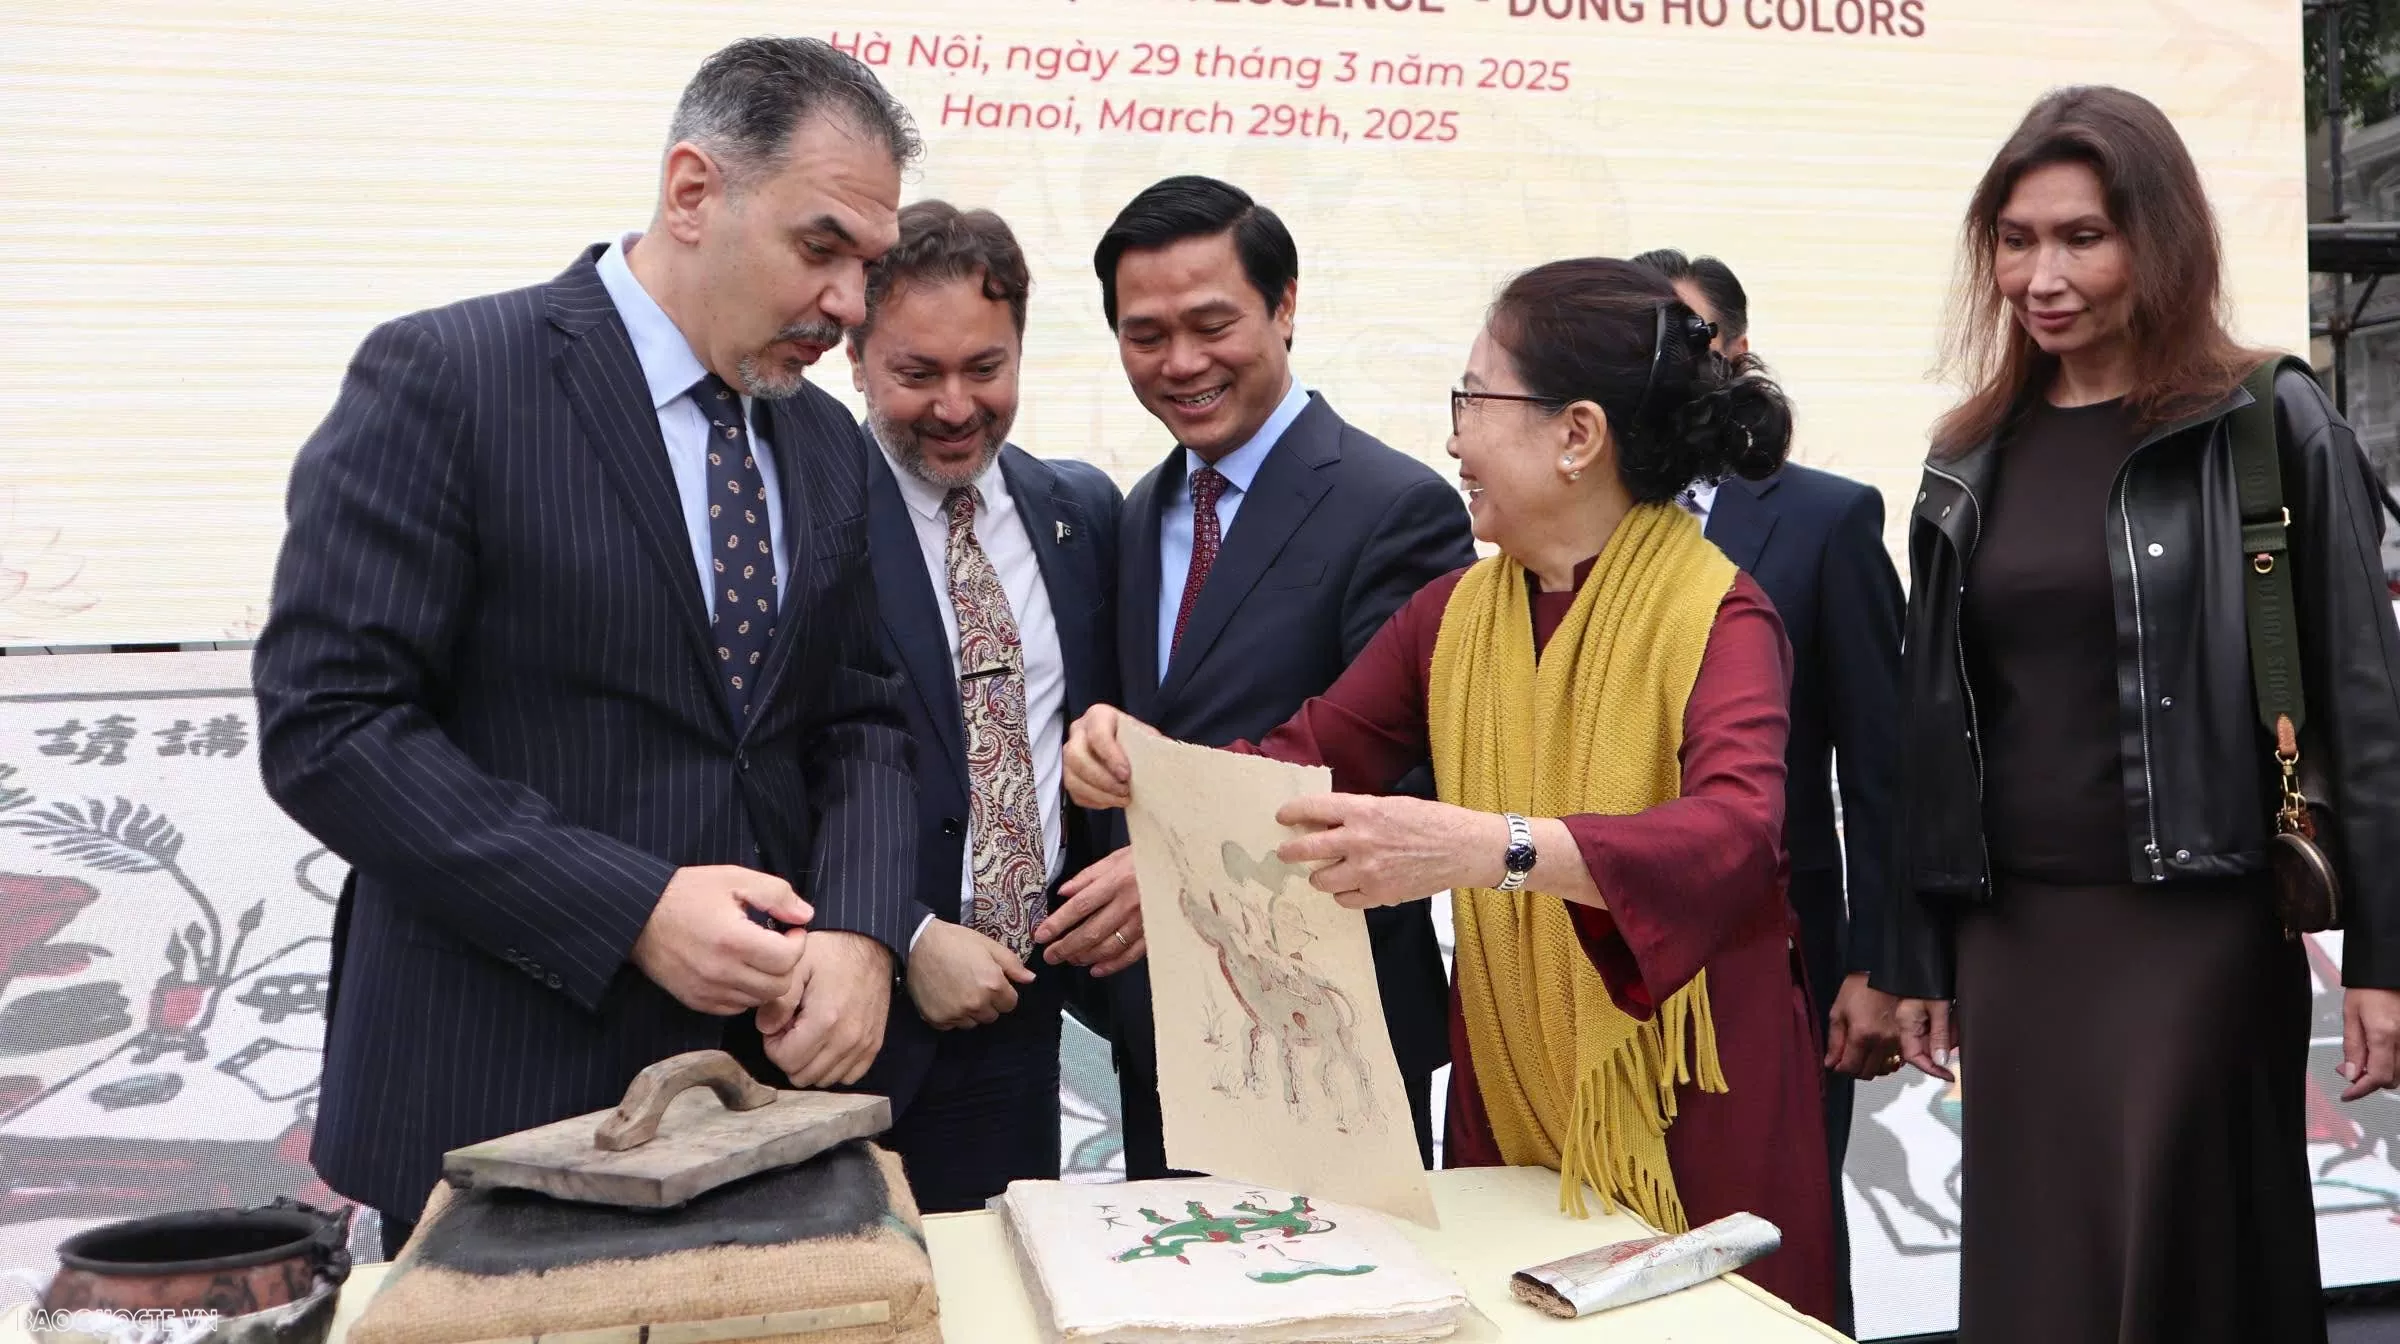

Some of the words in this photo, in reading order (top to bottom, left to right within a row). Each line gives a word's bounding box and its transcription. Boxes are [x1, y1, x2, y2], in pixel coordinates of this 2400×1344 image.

[1743, 0, 1927, 37] COLORS
[831, 31, 892, 66] Hà
[907, 34, 990, 77] Nội,
[1007, 40, 1119, 82] ngày
[1130, 43, 1180, 76] 29
[1194, 47, 1322, 90] tháng
[1334, 51, 1358, 83] 3
[1371, 54, 1465, 88] năm
[1477, 58, 1572, 92] 2025
[940, 93, 1082, 134] Hanoi,
[1099, 99, 1234, 134] March
[1248, 103, 1350, 142] 29th,
[1364, 109, 1461, 143] 2025
